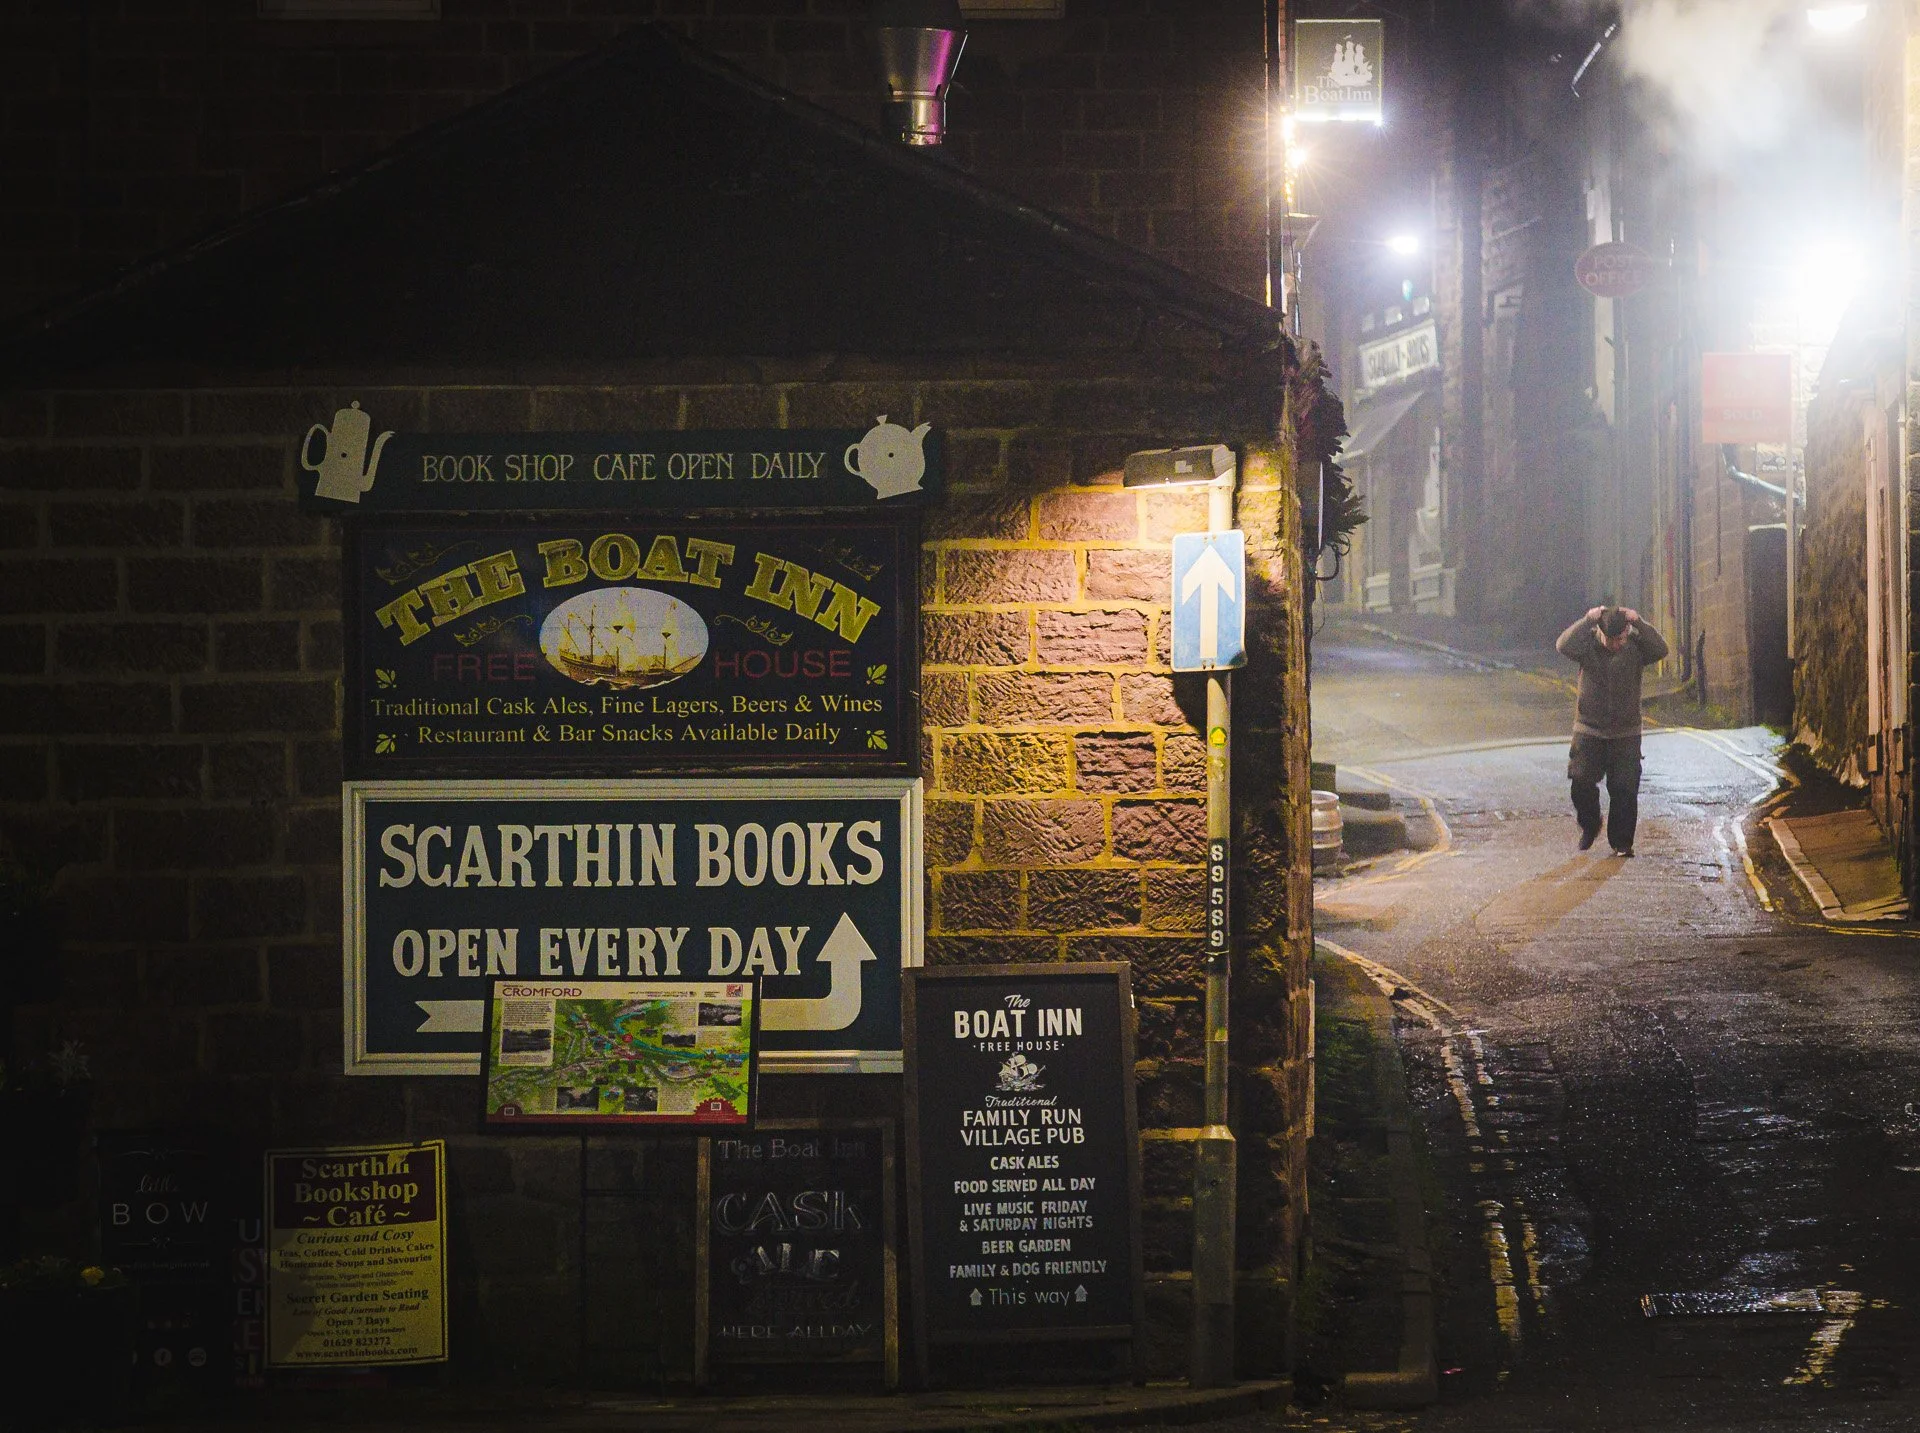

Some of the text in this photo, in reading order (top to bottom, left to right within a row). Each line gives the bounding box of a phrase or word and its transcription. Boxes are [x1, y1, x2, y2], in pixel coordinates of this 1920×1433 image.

[1303, 85, 1372, 104] Boat Inn
[421, 451, 826, 482] BOOK SHOP CAFE OPEN DAILY
[374, 532, 882, 647] THE BOAT INN
[431, 648, 852, 682] FREE HOUSE
[370, 693, 883, 718] Traditional Cask Ales, Fine Lagers, Beers & Wines
[418, 722, 841, 745] Restaurant & Bar Snacks Available Daily
[379, 820, 884, 889] SCARTHIN BOOKS
[392, 925, 811, 978] OPEN EVERY DAY
[502, 987, 582, 997] CROMFORD
[1004, 994, 1031, 1009] The
[954, 1007, 1083, 1039] BOAT INN
[980, 1040, 1060, 1052] FREE HOUSE
[985, 1095, 1058, 1109] Traditional
[963, 1108, 1081, 1127] FAMILY RUN
[960, 1127, 1085, 1146] VILLAGE PUB
[717, 1139, 763, 1159] The
[771, 1138, 820, 1158] Boat
[301, 1155, 410, 1179] Scarthin
[990, 1155, 1060, 1170] CASK ALES
[294, 1180, 419, 1204] Bookshop
[954, 1177, 1096, 1194] FOOD SERVED ALL DAY
[112, 1201, 208, 1225] BOW
[326, 1204, 387, 1227] Café
[964, 1200, 1088, 1216] LIVE MUSIC FRIDAY
[959, 1215, 1093, 1232] & SATURDAY NIGHTS
[297, 1229, 414, 1244] Curious and Cosy
[304, 1247, 340, 1258] Coffees,
[344, 1246, 366, 1257] Cold
[407, 1241, 435, 1252] Cakes
[982, 1239, 1071, 1254] BEER GARDEN
[280, 1254, 432, 1269] Homemade Soups and Savouries
[950, 1260, 1108, 1278] FAMILY & DOG FRIENDLY
[286, 1288, 429, 1305] Secret Garden Seating
[989, 1287, 1070, 1307] This way
[325, 1306, 347, 1315] Good
[349, 1305, 386, 1315] Journals
[398, 1302, 420, 1312] Read
[326, 1316, 391, 1328] Open 7 Days
[323, 1337, 391, 1348] 01629 823272
